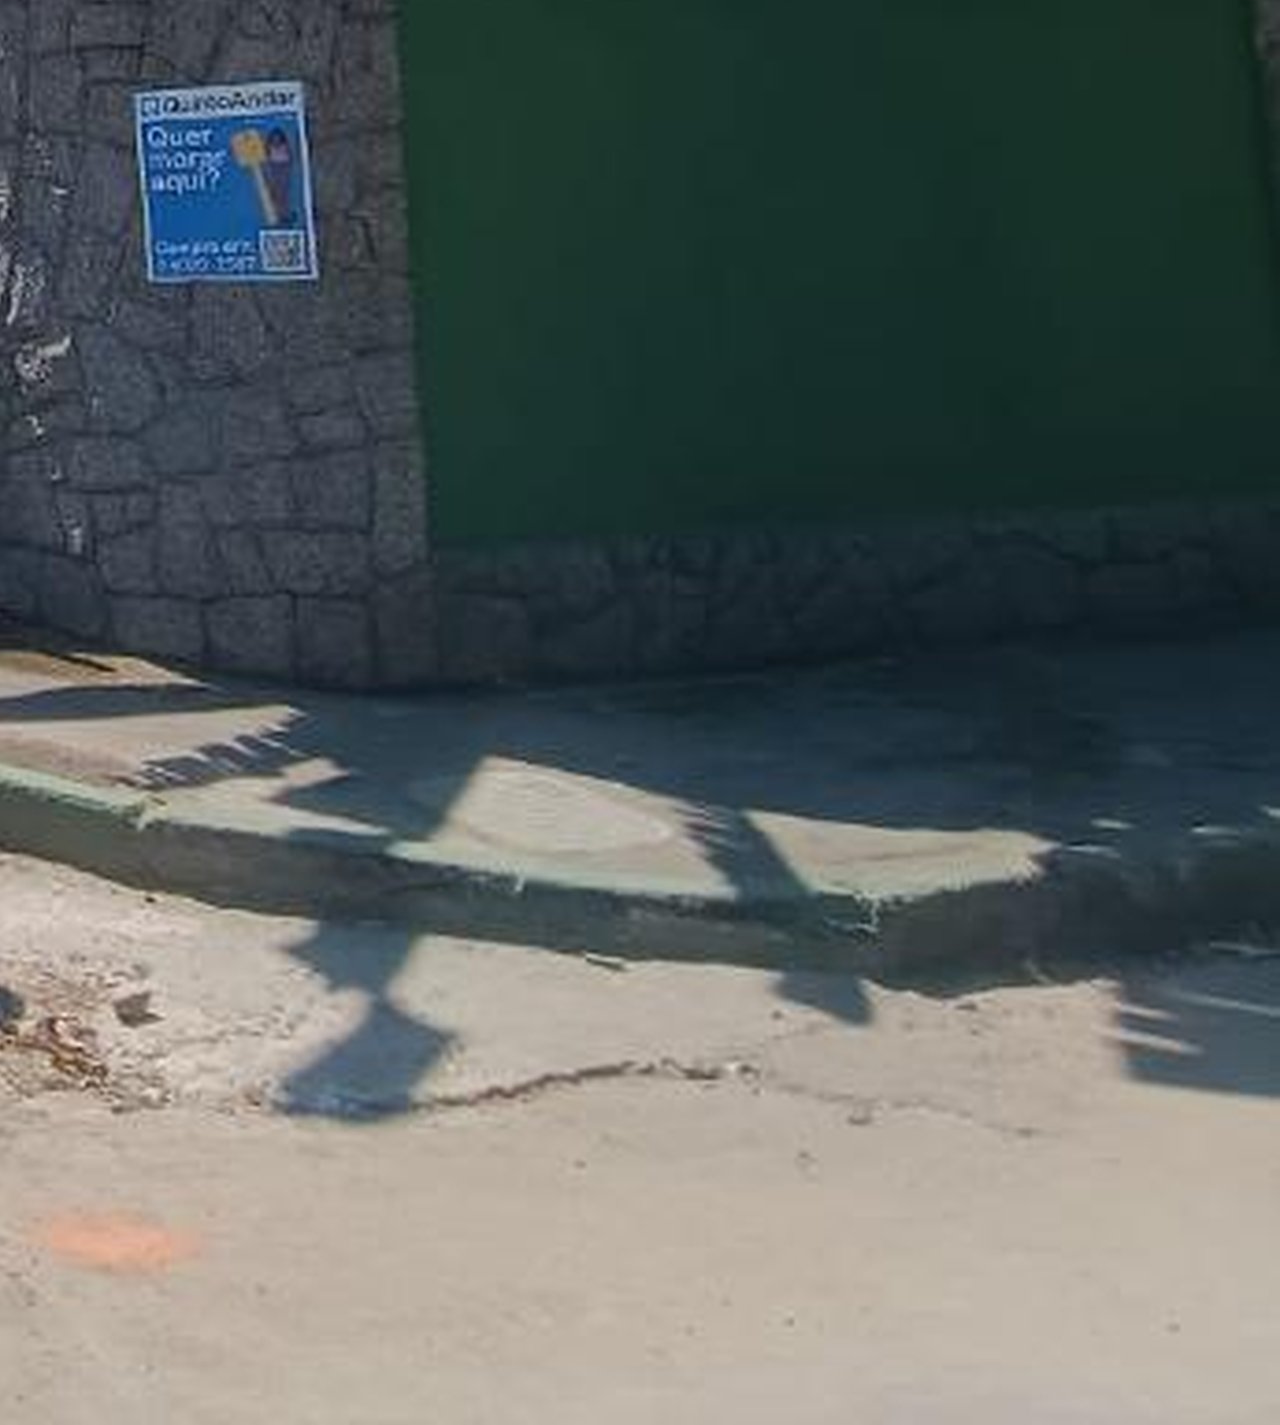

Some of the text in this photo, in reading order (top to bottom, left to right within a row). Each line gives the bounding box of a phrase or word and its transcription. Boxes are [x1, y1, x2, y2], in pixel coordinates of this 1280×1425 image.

[162, 91, 295, 113] QuintoAndar
[147, 127, 212, 147] Quer
[151, 169, 220, 195] aqui?
